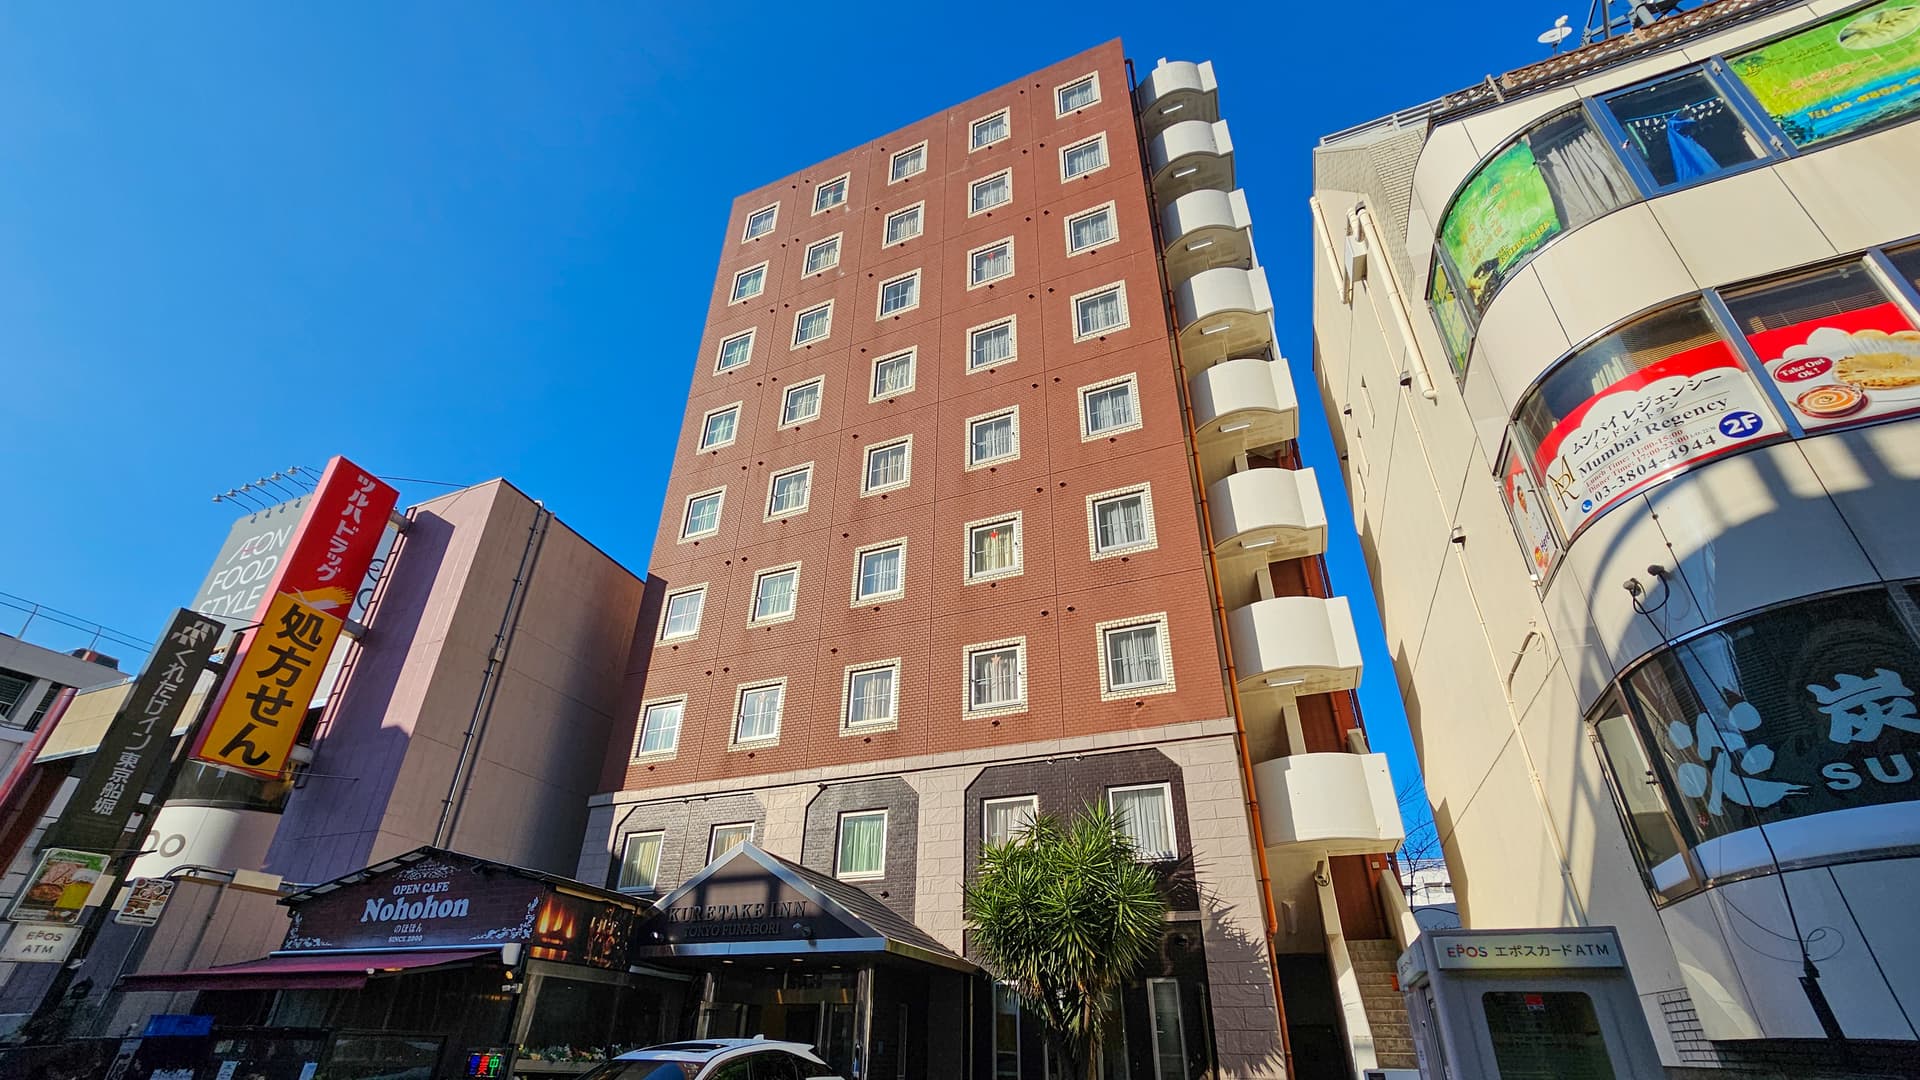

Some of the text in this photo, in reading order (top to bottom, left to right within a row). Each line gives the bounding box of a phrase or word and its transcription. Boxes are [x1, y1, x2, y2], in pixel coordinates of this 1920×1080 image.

[1781, 358, 1825, 377] Take Out
[1573, 375, 1721, 455] ムンバイ レジェンシー
[1593, 400, 1679, 450] インドレストラン
[1724, 413, 1758, 435] 2F
[1578, 398, 1728, 478] Mumbai Regency
[1586, 468, 1606, 487] Lunch
[1631, 428, 1684, 458] 11:00-15:00
[1588, 475, 1611, 494] Dinner
[1636, 435, 1690, 463] 17:00-23:00
[1594, 434, 1716, 502] 03-3804-4944
[316, 474, 376, 581] ツルハドラッグ
[207, 555, 277, 595] FOOD
[219, 603, 324, 766] 処方せん
[1822, 752, 1920, 791] SU
[392, 881, 450, 895] OPEN CAFE
[360, 895, 469, 923] Nohohon
[668, 900, 808, 922] KURETAKE INN
[26, 930, 63, 942] EPOS
[393, 923, 423, 933] のほほん
[684, 922, 780, 937] TOKYO FUNABORI
[22, 945, 53, 953] ATM
[1447, 943, 1488, 958] EPOS
